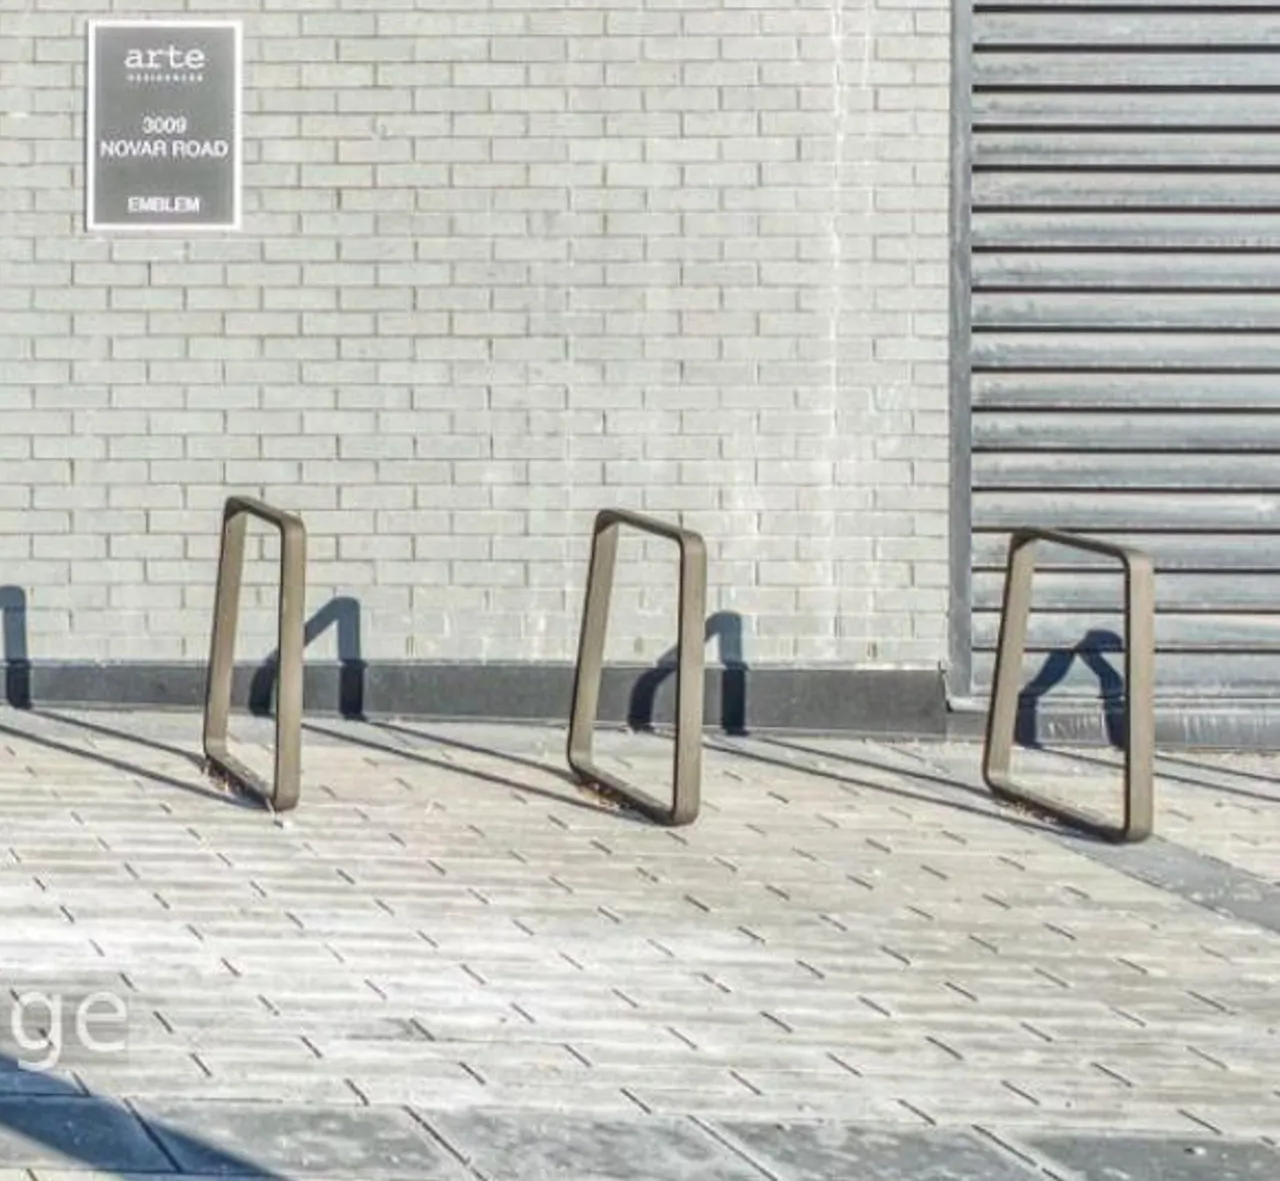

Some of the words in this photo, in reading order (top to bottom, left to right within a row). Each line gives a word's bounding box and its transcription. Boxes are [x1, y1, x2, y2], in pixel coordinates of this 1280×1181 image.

[124, 45, 206, 69] arte
[142, 116, 188, 134] 3009
[100, 139, 168, 158] NOVAR
[172, 139, 229, 158] ROAD
[127, 196, 201, 213] EMBLEM
